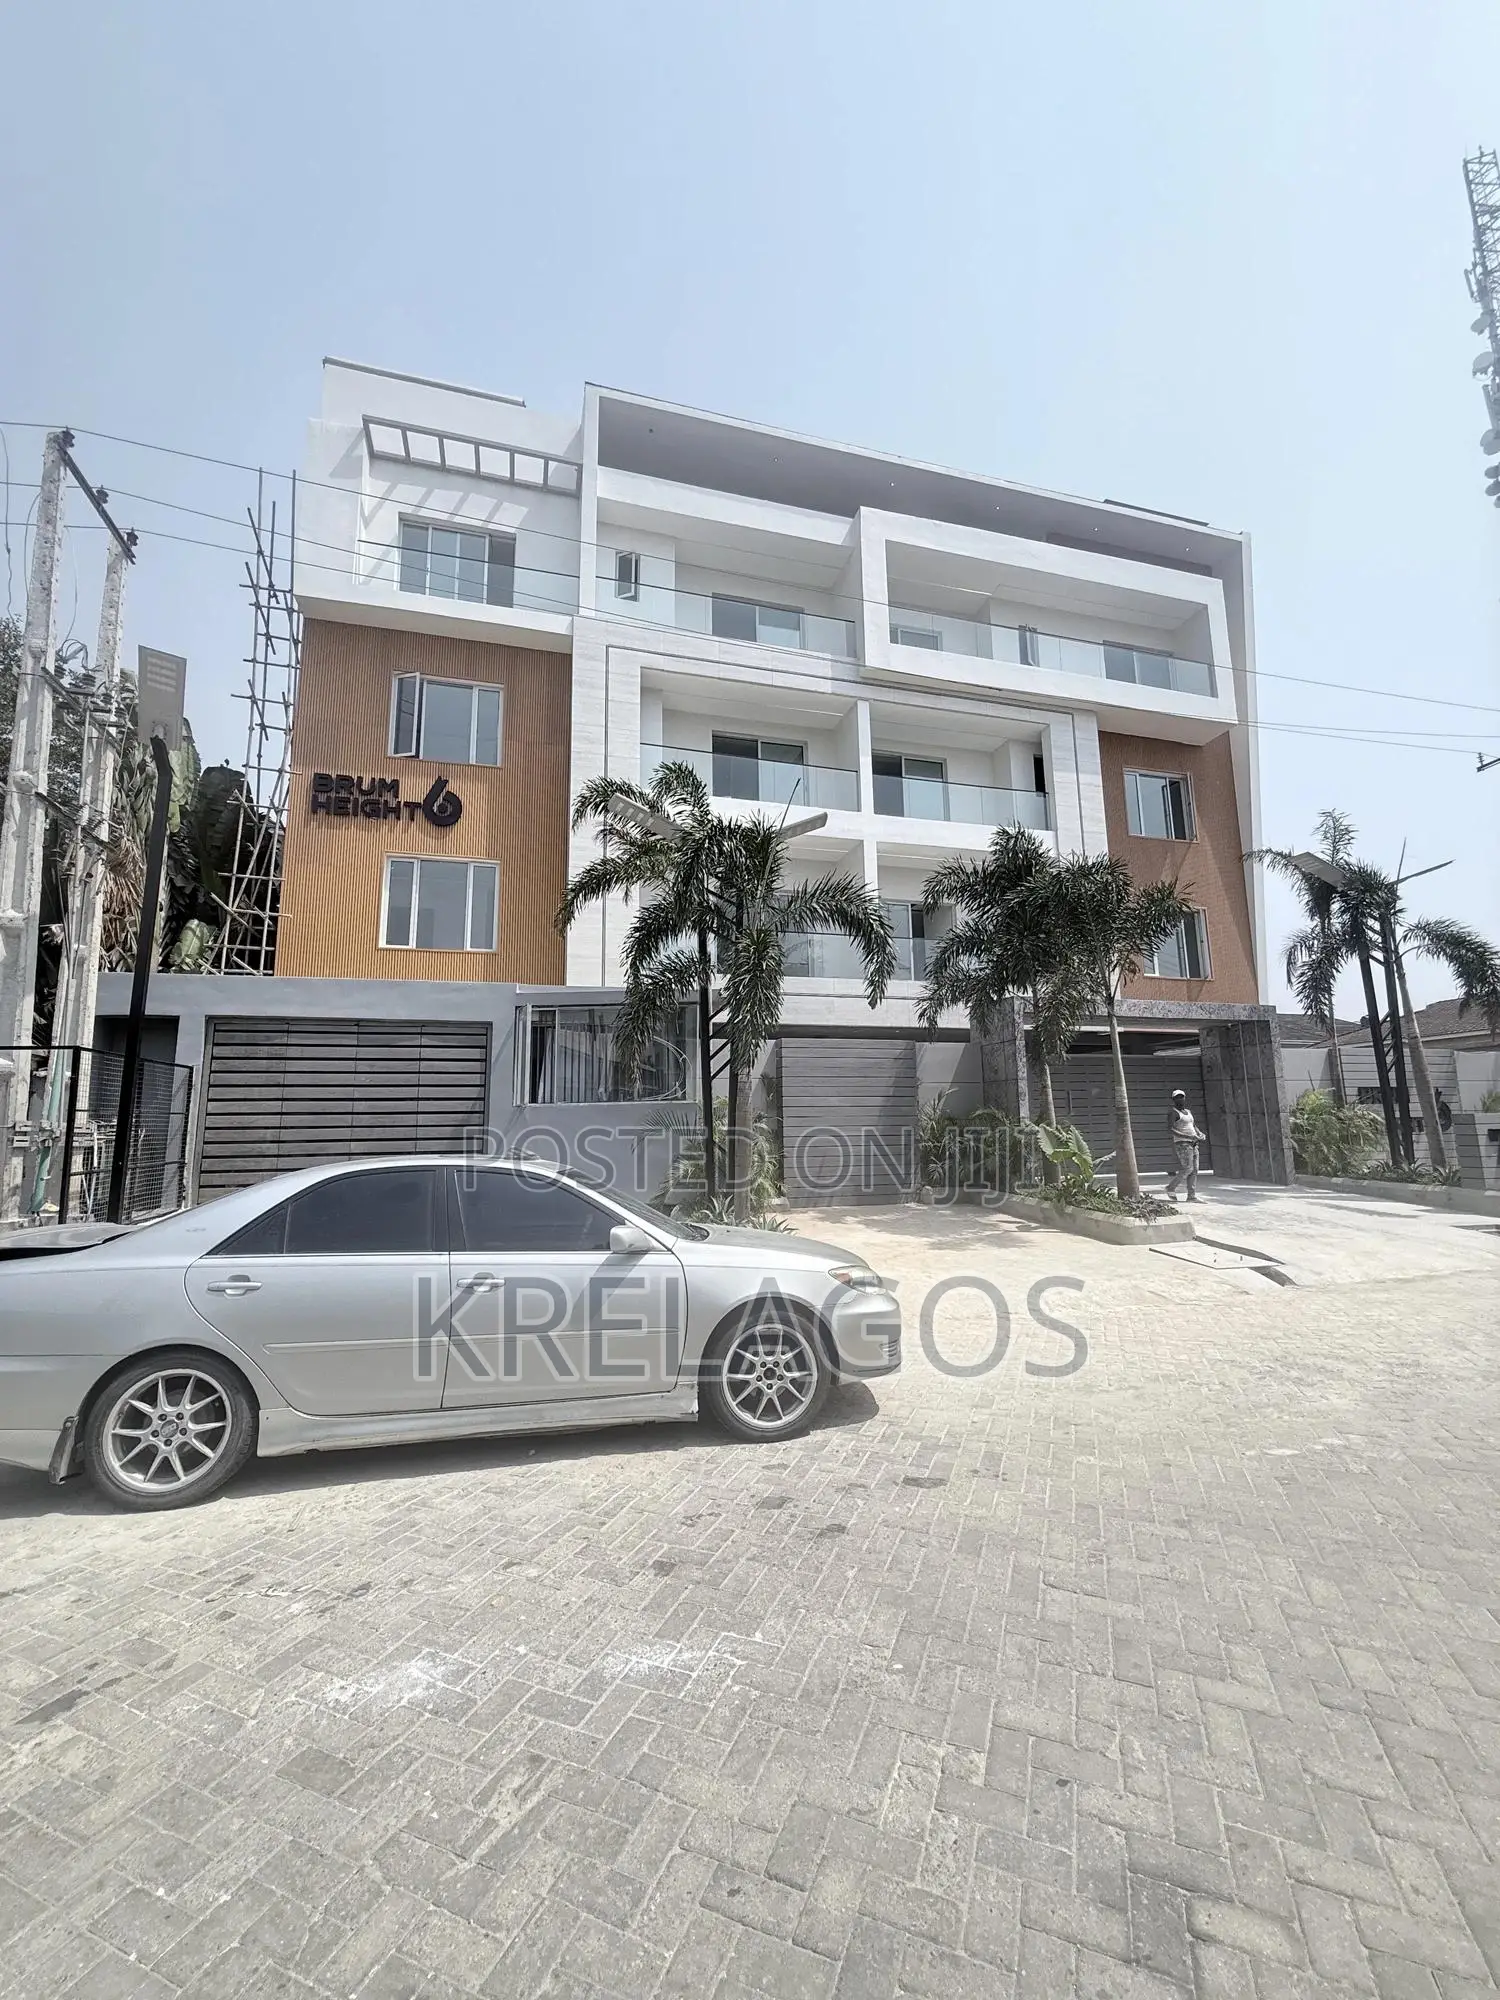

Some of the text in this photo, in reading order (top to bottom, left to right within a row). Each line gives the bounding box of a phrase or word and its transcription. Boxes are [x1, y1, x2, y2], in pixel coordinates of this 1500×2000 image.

[311, 775, 463, 827] HEIGHT 6
[313, 772, 400, 798] BRUM
